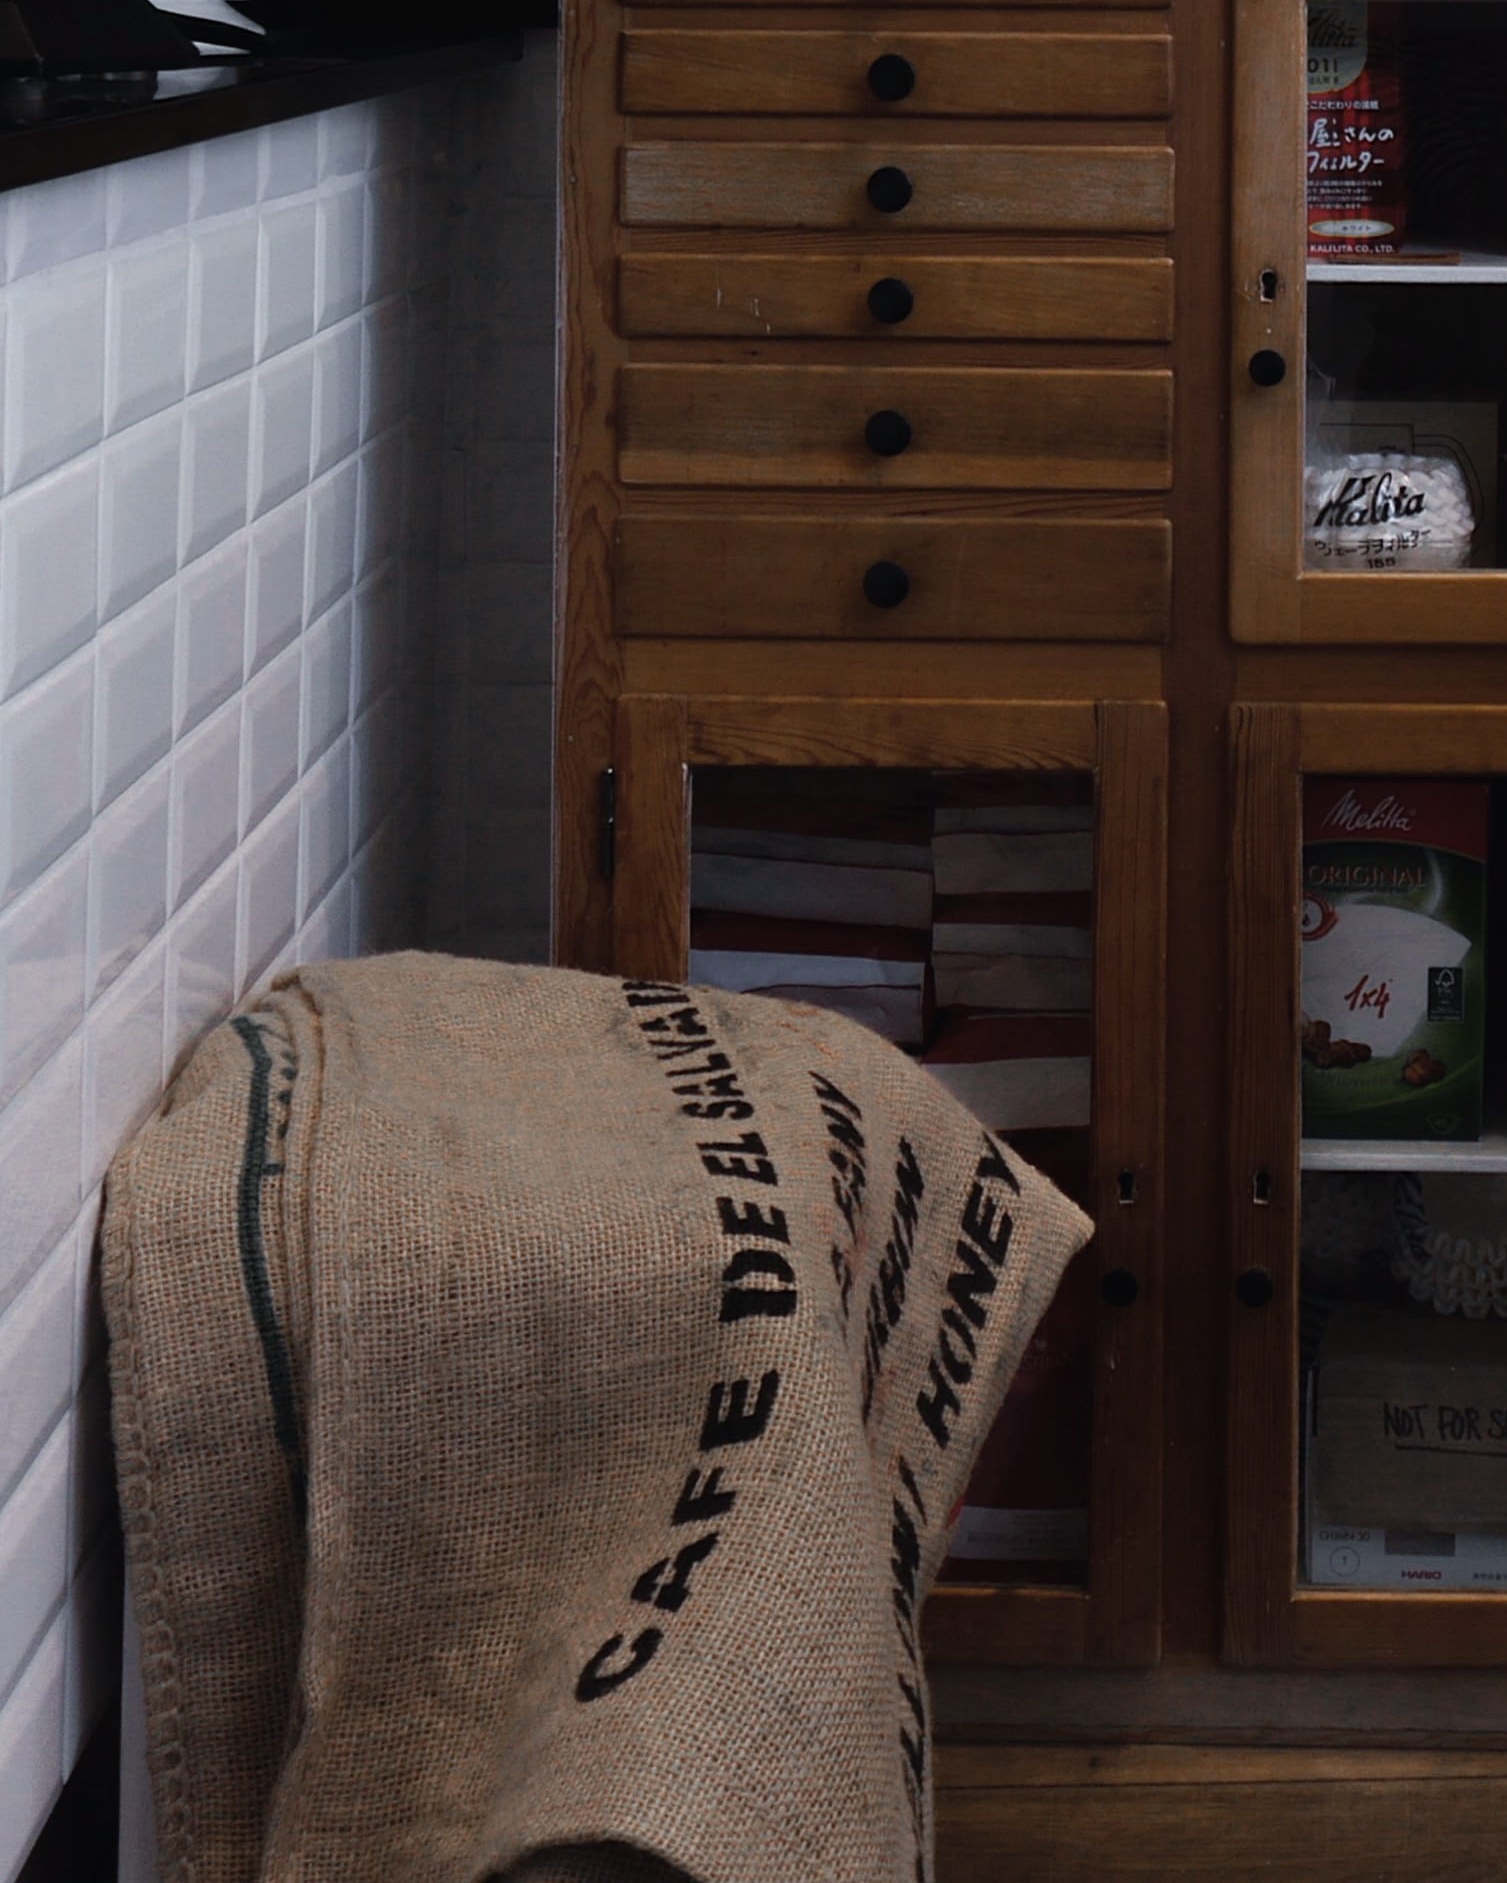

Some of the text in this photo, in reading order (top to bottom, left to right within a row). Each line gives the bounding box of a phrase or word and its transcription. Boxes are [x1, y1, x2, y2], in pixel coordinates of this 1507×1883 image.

[1314, 472, 1425, 527] Kalita
[1320, 787, 1416, 832] Melitta
[1308, 865, 1427, 887] ORIGINAL
[697, 1130, 780, 1188] EL
[716, 1195, 798, 1323] DE
[916, 1130, 1024, 1449] HONEY
[1383, 1402, 1428, 1440] NOT
[1437, 1406, 1481, 1441] FOR
[575, 1368, 780, 1703] CAFE
